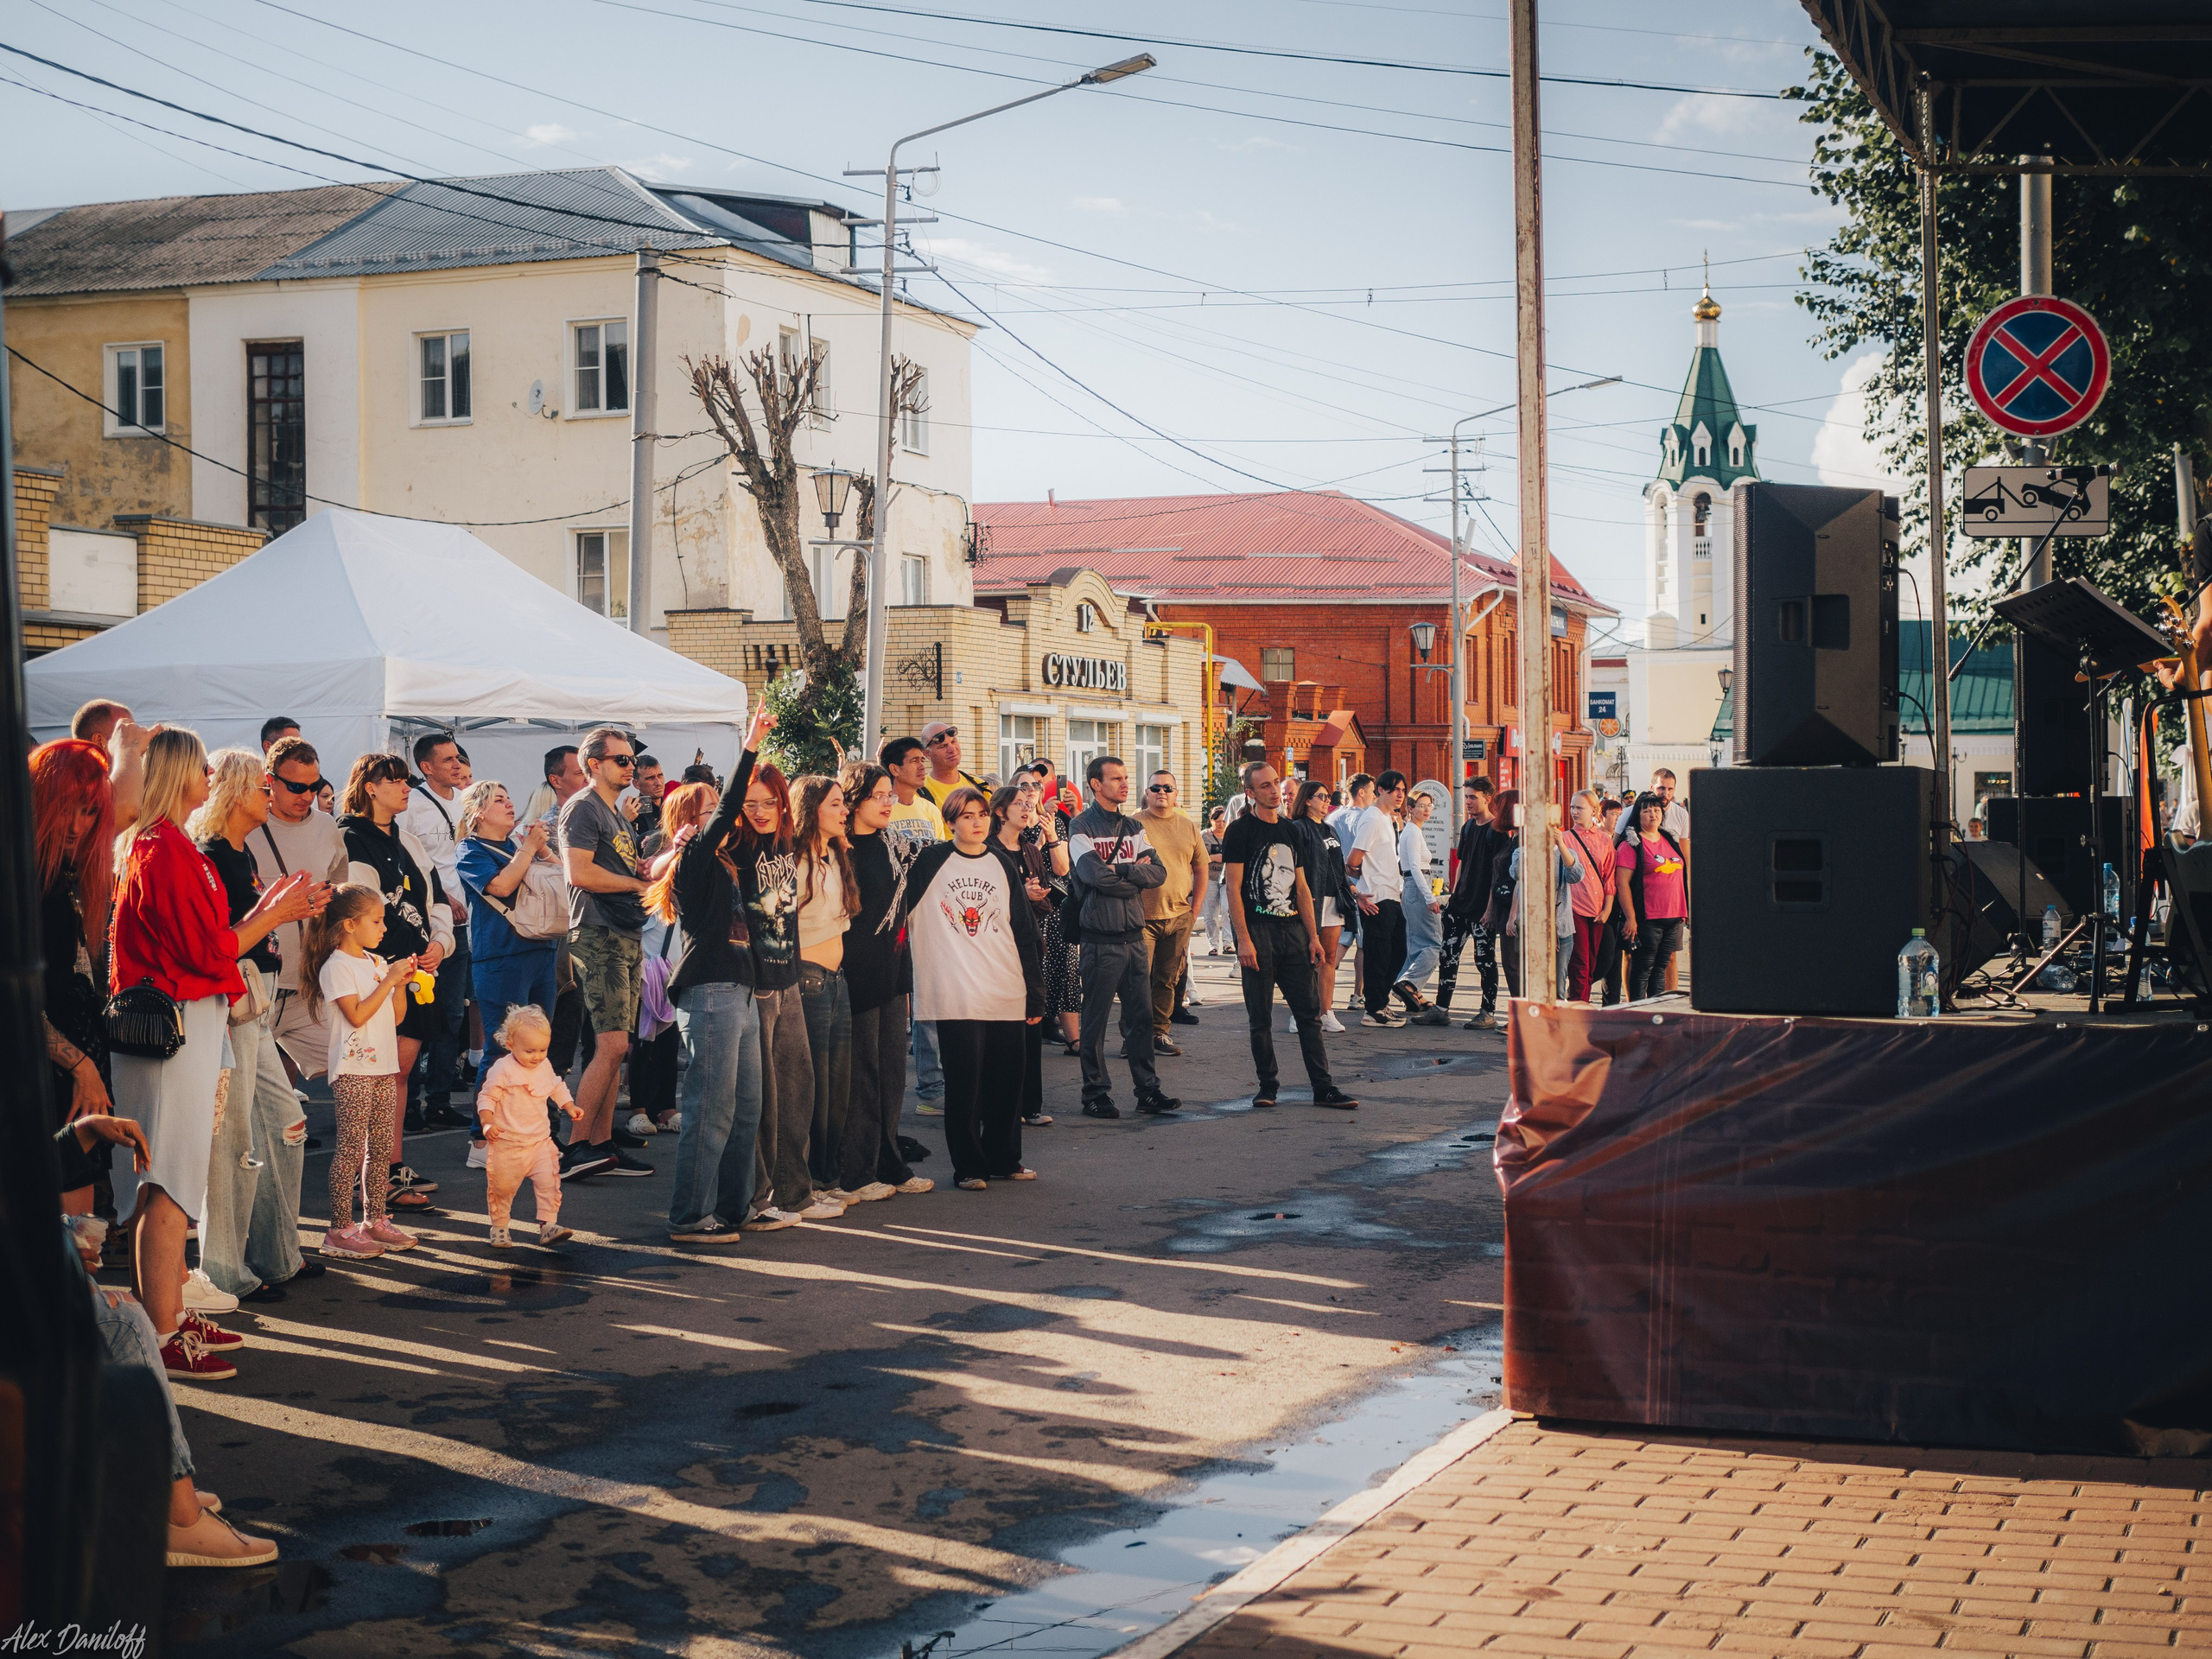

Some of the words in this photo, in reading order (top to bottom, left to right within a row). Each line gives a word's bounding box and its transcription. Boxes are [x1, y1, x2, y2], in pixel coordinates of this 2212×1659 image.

[1080, 604, 1095, 632] 12
[1046, 652, 1127, 690] СТУЛЬЕВ
[961, 890, 983, 901] CLUB
